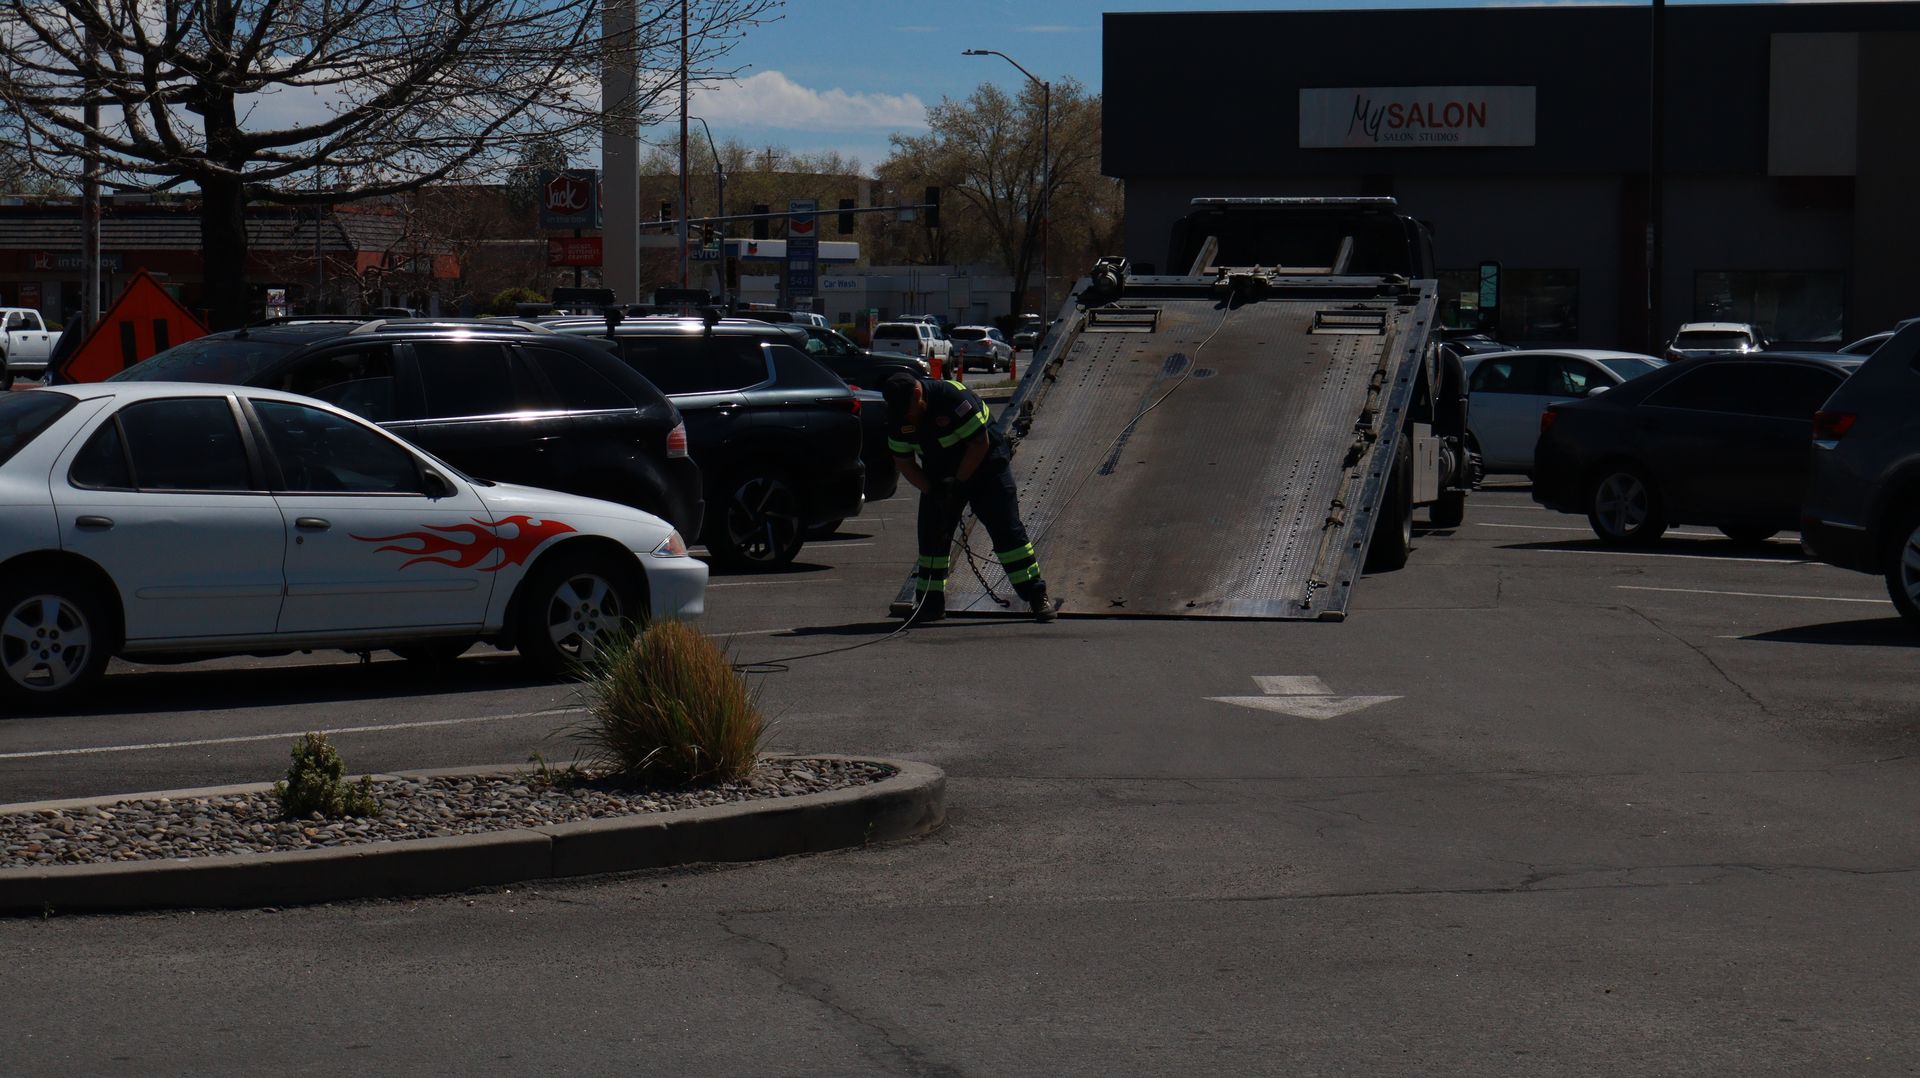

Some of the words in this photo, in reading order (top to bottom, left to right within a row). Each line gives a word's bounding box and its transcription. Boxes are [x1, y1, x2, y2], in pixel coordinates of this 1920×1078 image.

[1348, 94, 1385, 142] My
[1387, 102, 1486, 128] SALON
[1383, 132, 1414, 142] SALON
[1418, 132, 1459, 142] STUDIOS
[546, 180, 588, 210] Jack
[823, 280, 836, 288] Car
[838, 280, 857, 288] Wash
